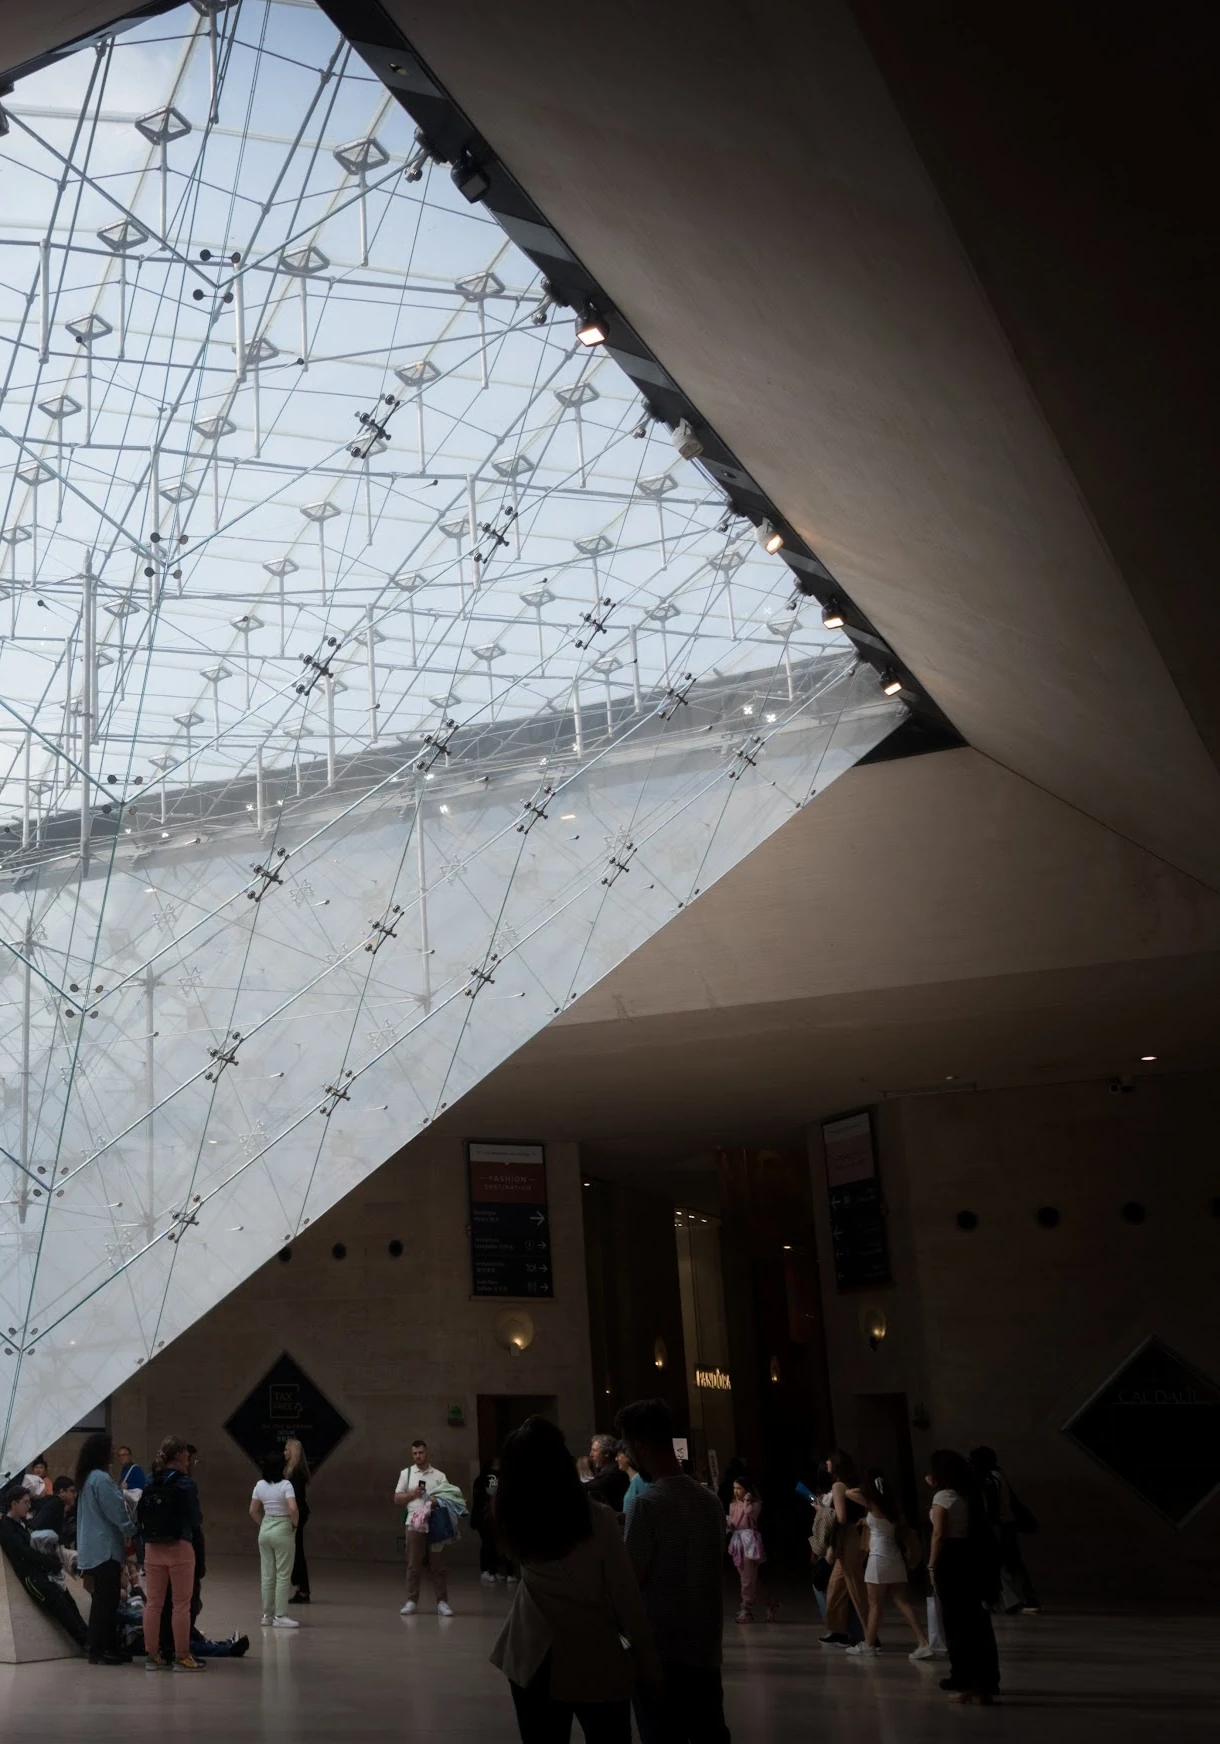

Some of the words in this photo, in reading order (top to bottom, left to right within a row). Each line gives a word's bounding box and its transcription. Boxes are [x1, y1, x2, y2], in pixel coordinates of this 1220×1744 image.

[488, 1175, 527, 1183] FASHION
[696, 1368, 732, 1390] PANDORA
[274, 1391, 293, 1401] TAX
